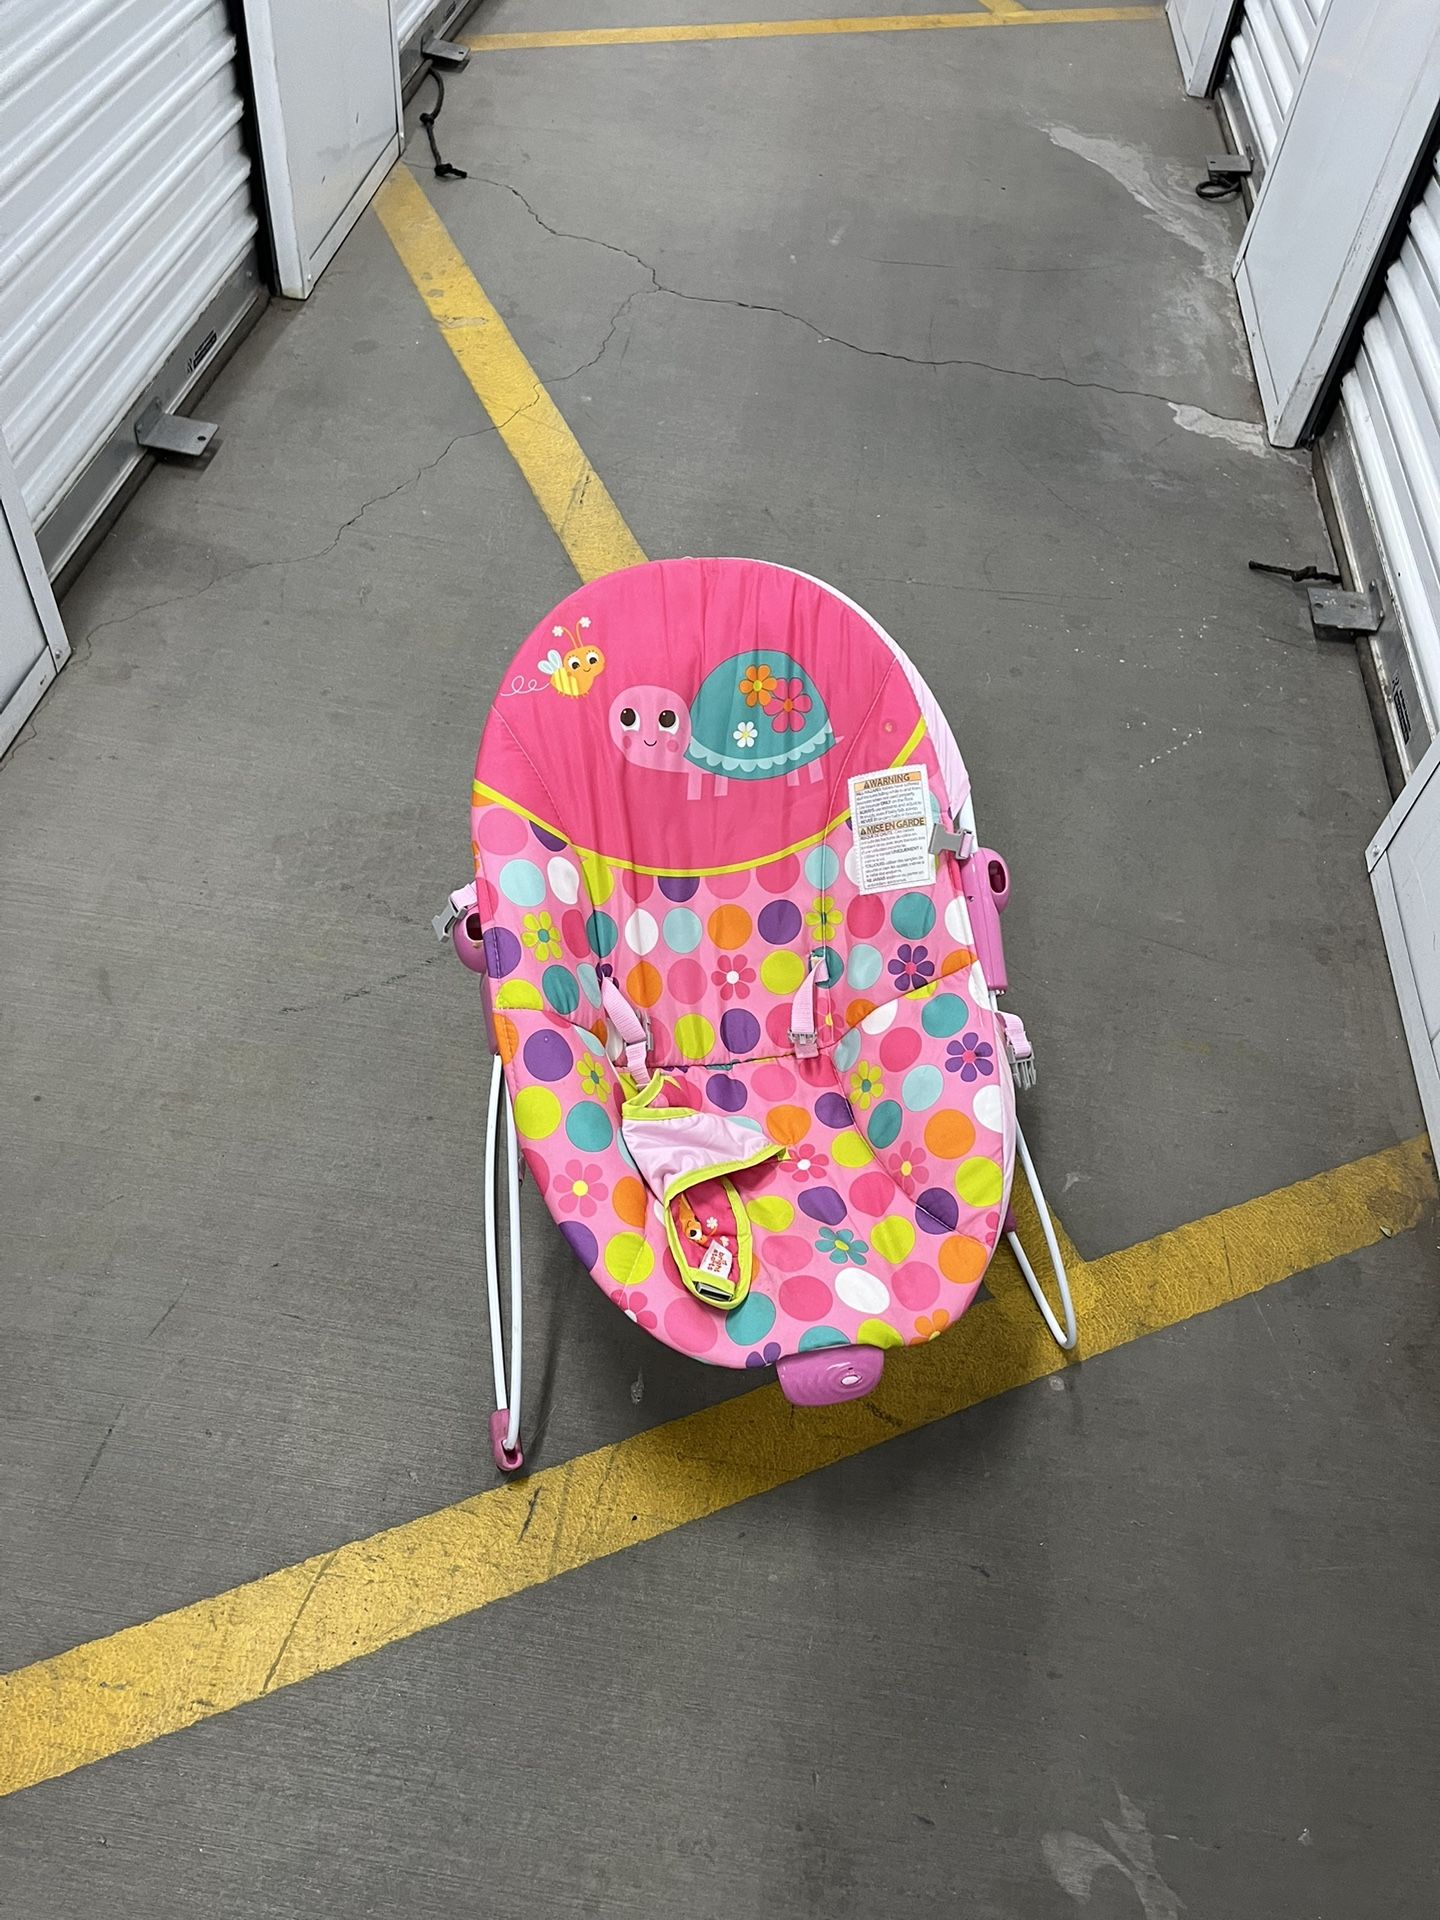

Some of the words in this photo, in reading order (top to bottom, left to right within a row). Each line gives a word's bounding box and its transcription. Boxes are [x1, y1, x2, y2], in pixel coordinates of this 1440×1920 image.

[870, 773, 910, 788] WARNING
[867, 823, 885, 835] MISE
[885, 821, 896, 831] EN
[896, 817, 926, 828] GARDE
